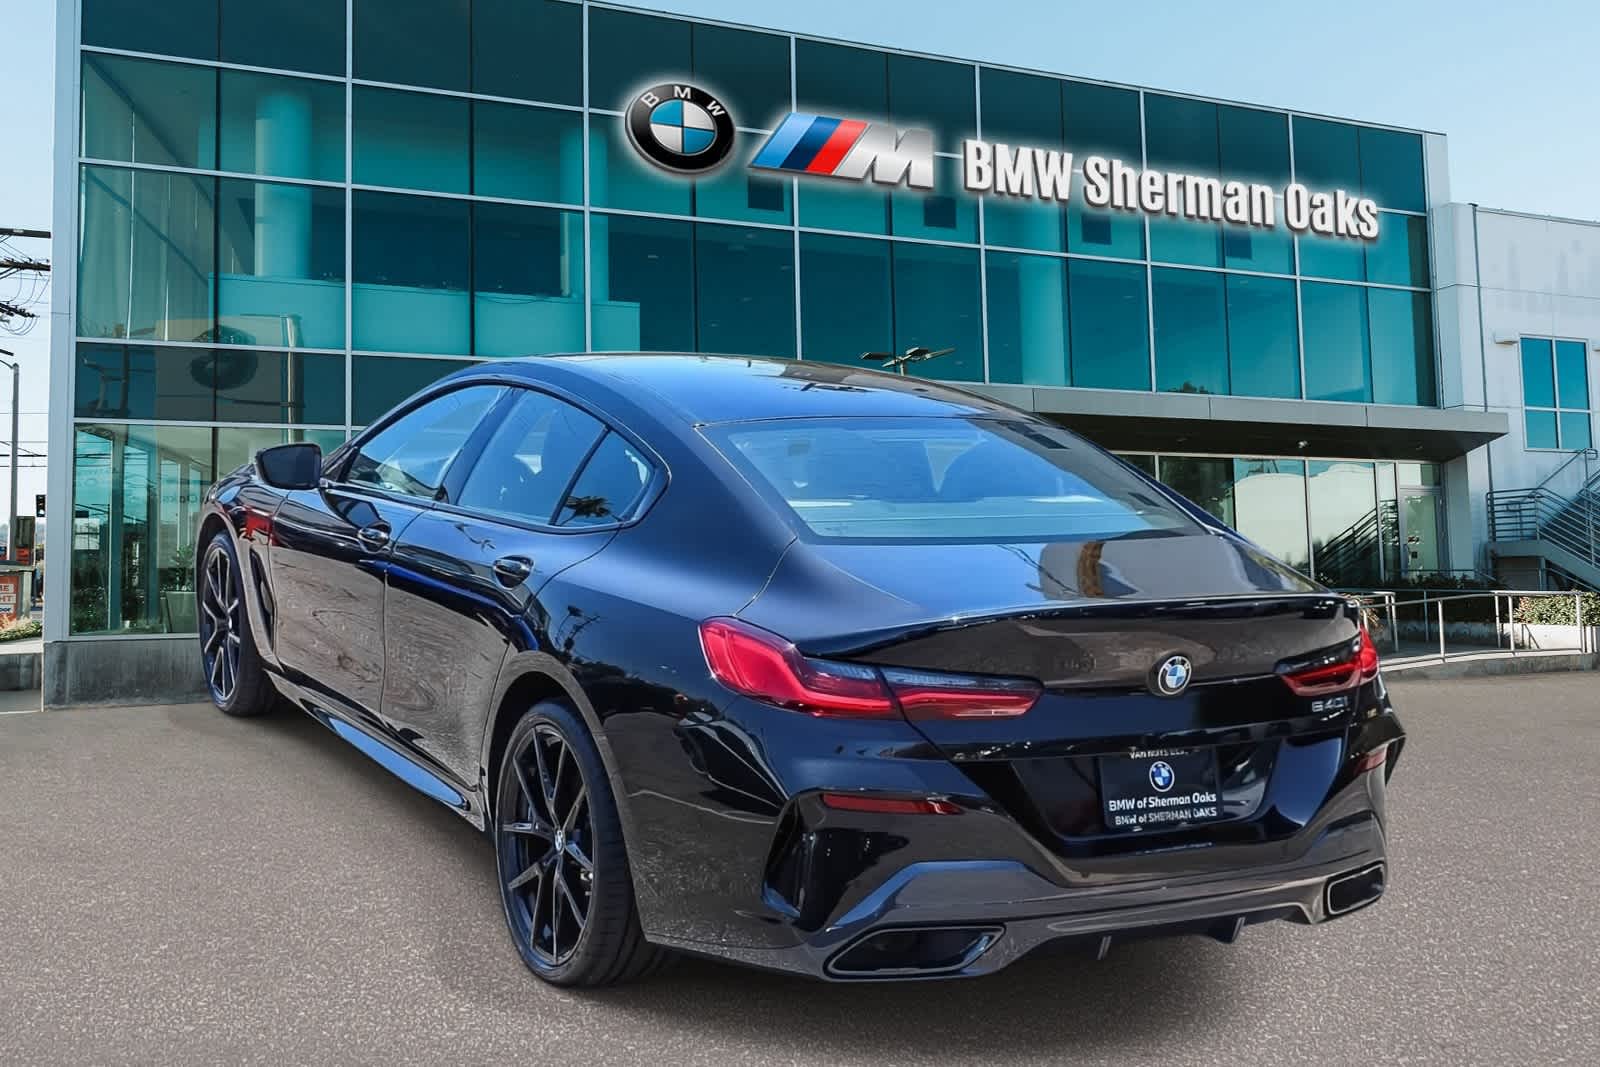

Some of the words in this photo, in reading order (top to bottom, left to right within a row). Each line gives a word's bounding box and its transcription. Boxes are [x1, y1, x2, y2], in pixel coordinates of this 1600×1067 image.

[641, 85, 725, 117] BMW
[964, 139, 1073, 201] BMW
[1083, 156, 1275, 227] Sherman
[1284, 183, 1379, 240] Oaks
[1108, 798, 1136, 811] BMW
[1136, 797, 1148, 809] of
[1148, 794, 1191, 808] Sherman
[1192, 791, 1217, 804] Oaks
[1115, 814, 1137, 825] BMW
[1138, 814, 1148, 823] of
[1148, 809, 1192, 822] SHERMAN
[1193, 806, 1217, 818] OAKS
